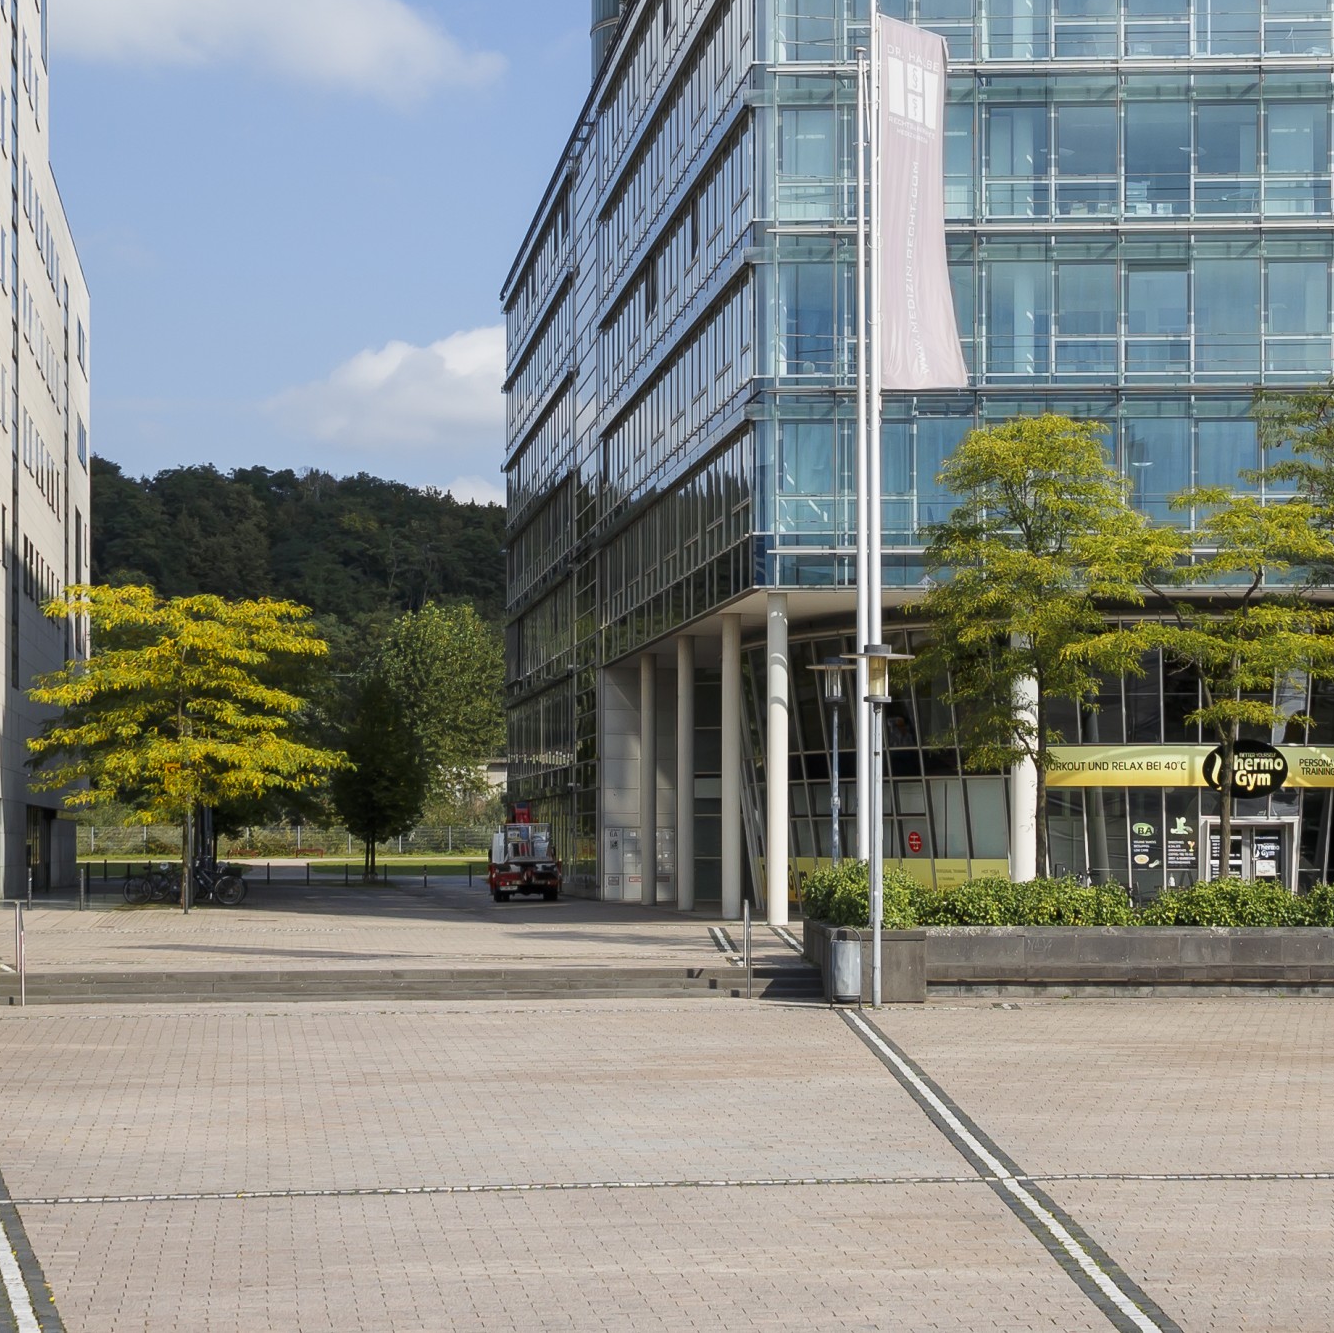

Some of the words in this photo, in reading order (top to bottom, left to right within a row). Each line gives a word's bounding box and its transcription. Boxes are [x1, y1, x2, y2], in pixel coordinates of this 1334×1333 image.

[887, 45, 904, 58] DR.
[1088, 761, 1109, 771] UND
[1112, 761, 1144, 771] RELAX
[1146, 761, 1162, 771] BEI
[1164, 761, 1187, 771] 40°C
[1233, 754, 1284, 771] hermo
[1235, 769, 1271, 791] Gym
